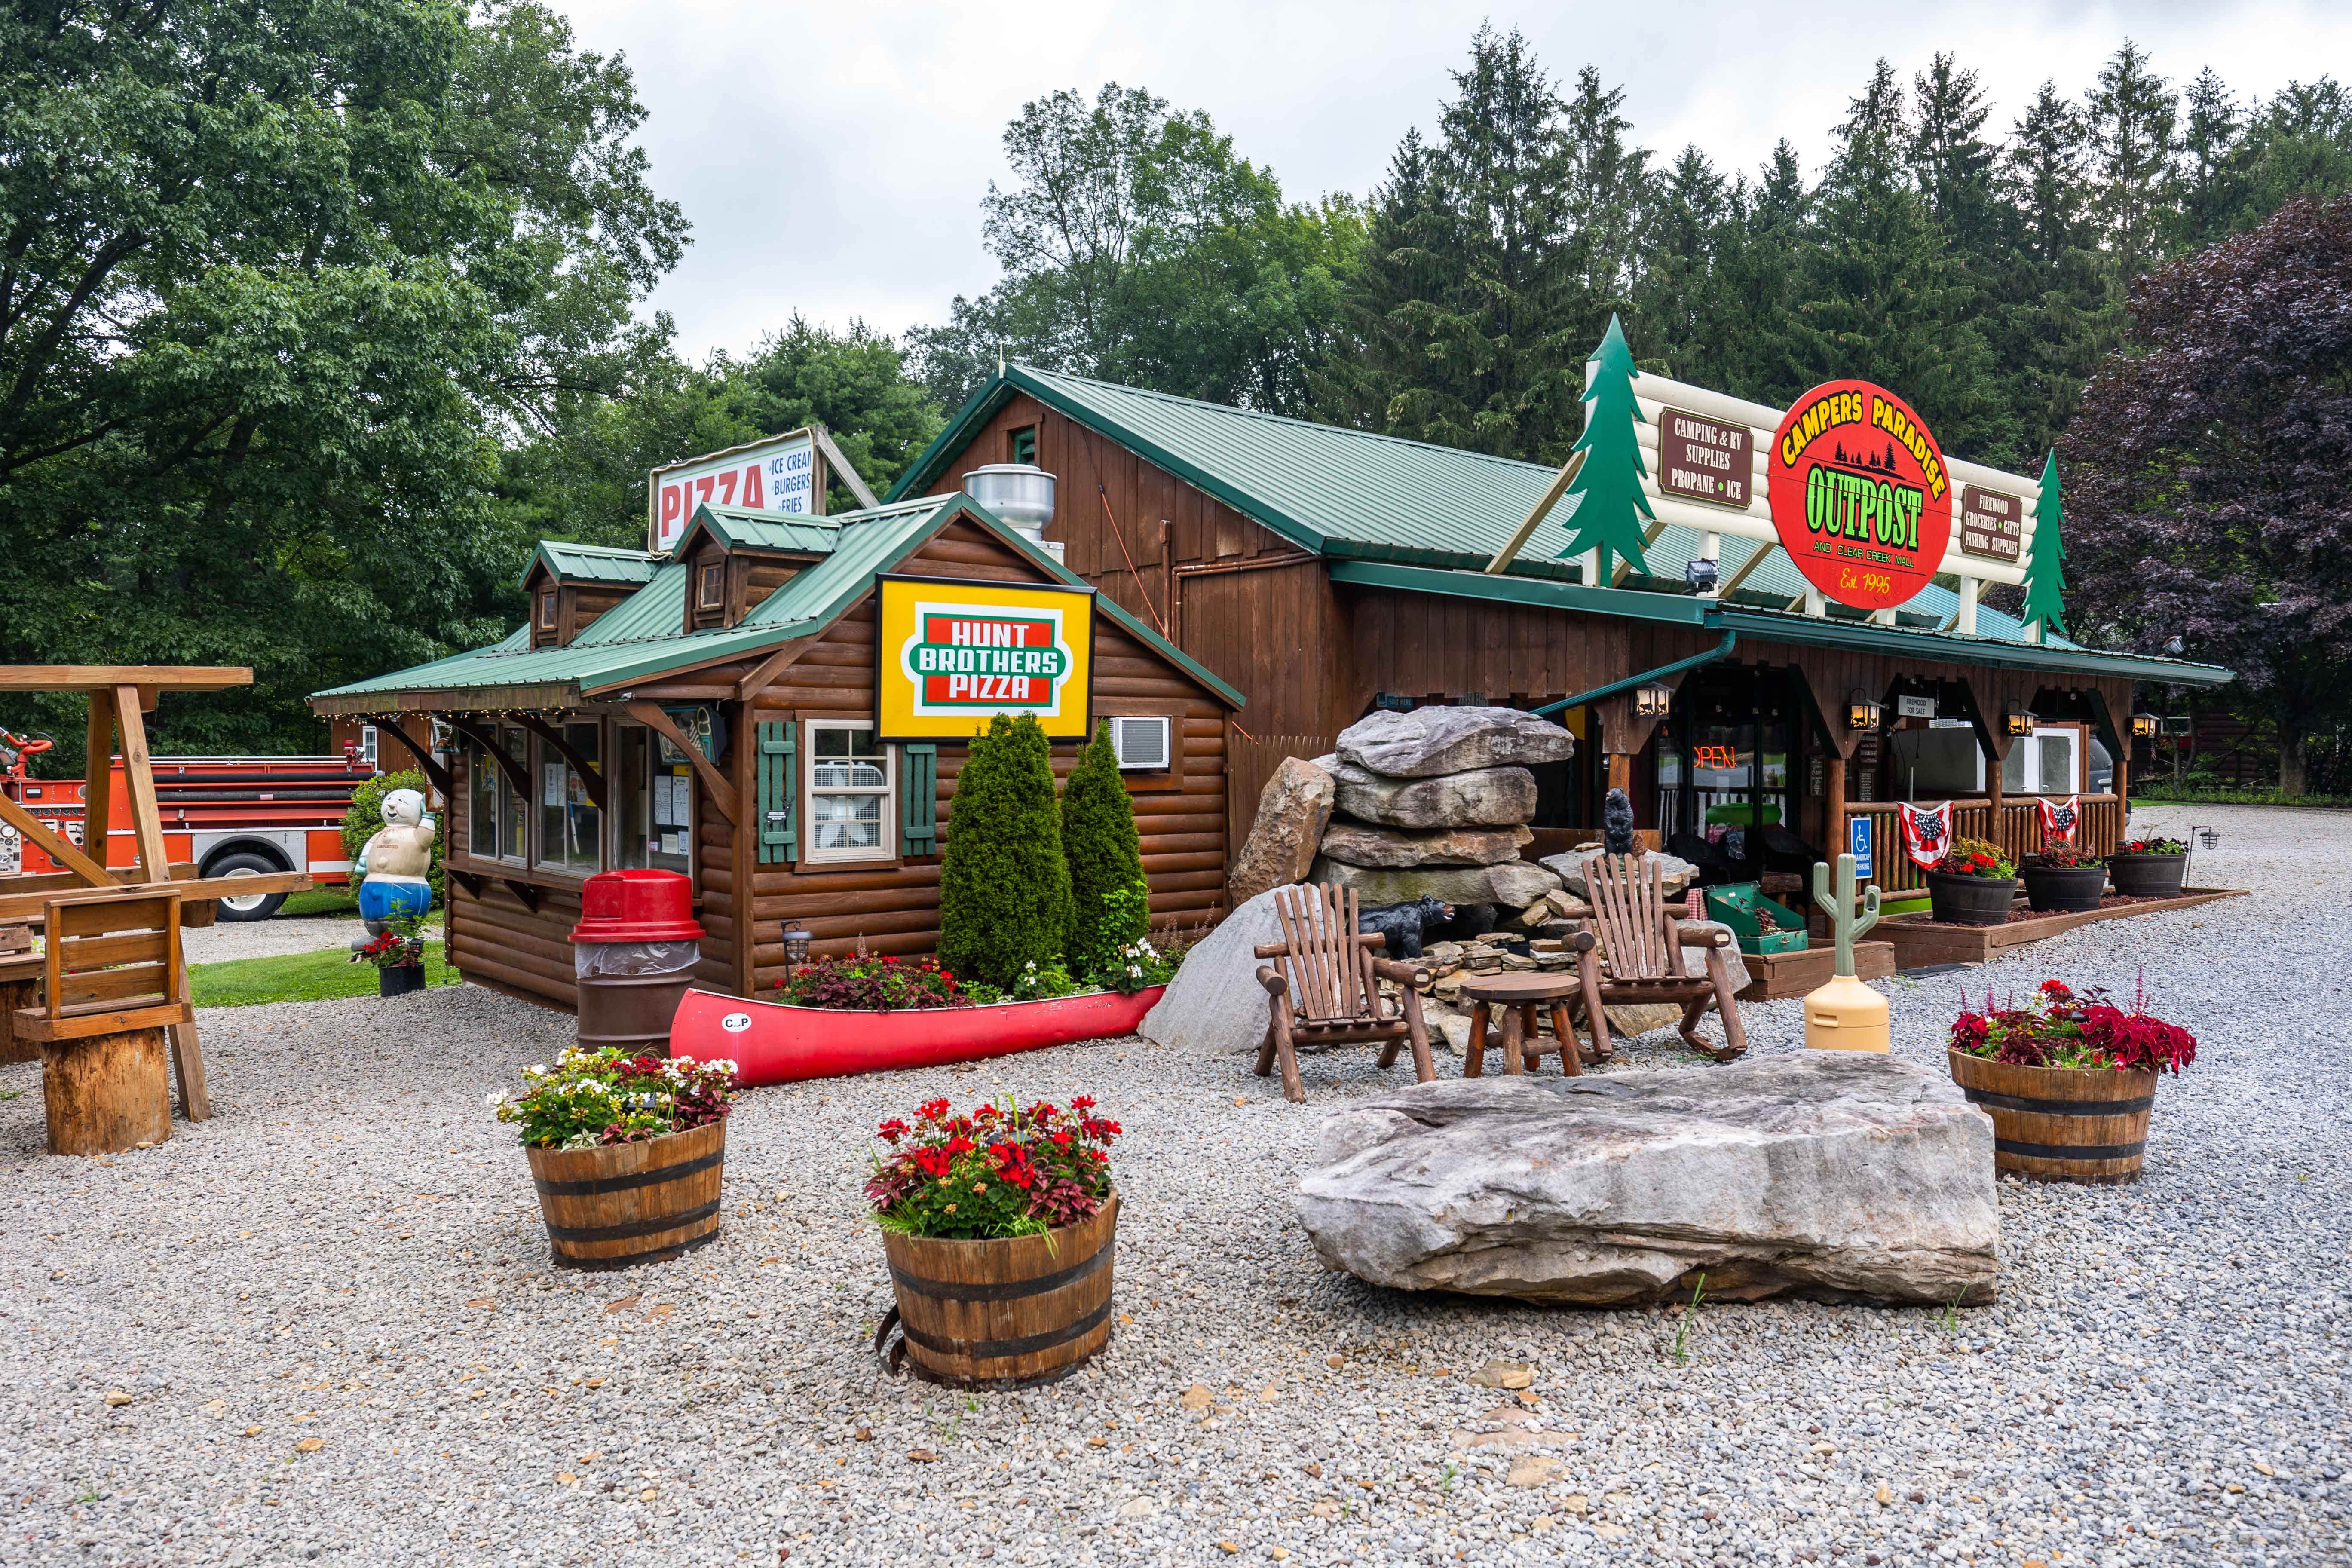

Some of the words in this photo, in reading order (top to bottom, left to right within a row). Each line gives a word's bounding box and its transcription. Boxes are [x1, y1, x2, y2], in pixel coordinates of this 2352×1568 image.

[1675, 417, 1717, 445] CAMPING
[1719, 431, 1727, 446] &
[1730, 431, 1742, 450] RV
[1781, 390, 1863, 468] CAMPERS
[1871, 395, 1947, 502] PARADISE
[772, 458, 784, 475] ICE
[1686, 444, 1730, 470] SUPPLIES
[775, 473, 810, 495] BURGERS
[1671, 468, 1714, 494] PROPANE
[1727, 480, 1741, 499] ICE
[782, 496, 802, 513] FRIES
[1806, 463, 1923, 552] OUTPOST
[1979, 494, 2009, 514] FIREWOOD
[1966, 511, 1997, 531] GROCERIES
[2003, 520, 2020, 536] GIFTS
[1813, 541, 1831, 554] AND
[1837, 545, 1863, 559] CLEAR
[1866, 550, 1892, 564] CREEK
[1894, 555, 1914, 567] MALL
[1965, 531, 1988, 549] FISHING
[1992, 537, 2018, 555] SUPPLIES
[1862, 573, 1890, 594] 1995
[952, 622, 1029, 648] HUNT
[919, 648, 1058, 674] BROTHERS
[949, 674, 1029, 699] PIZZA
